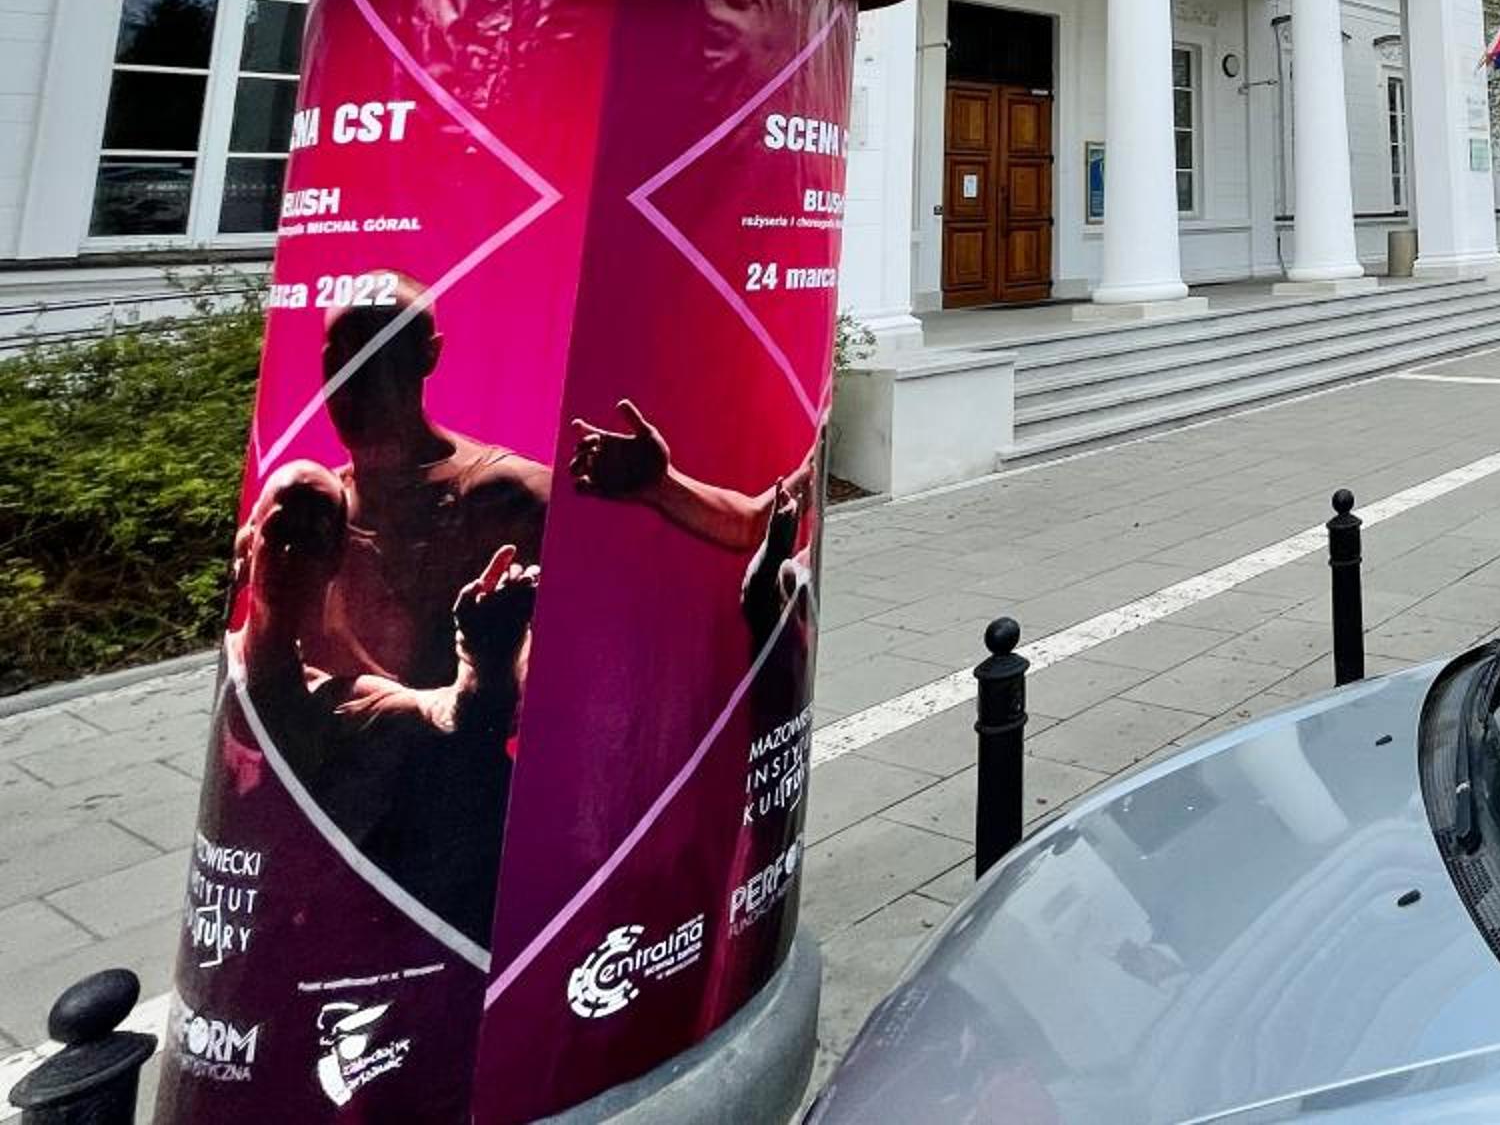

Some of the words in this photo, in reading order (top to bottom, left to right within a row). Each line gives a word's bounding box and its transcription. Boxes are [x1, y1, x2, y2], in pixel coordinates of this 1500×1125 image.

[332, 101, 416, 144] CST
[764, 113, 839, 157] SCENA
[362, 215, 421, 232] GÓRAL
[314, 273, 400, 308] 2022
[745, 262, 778, 291] 24
[785, 268, 838, 289] marca
